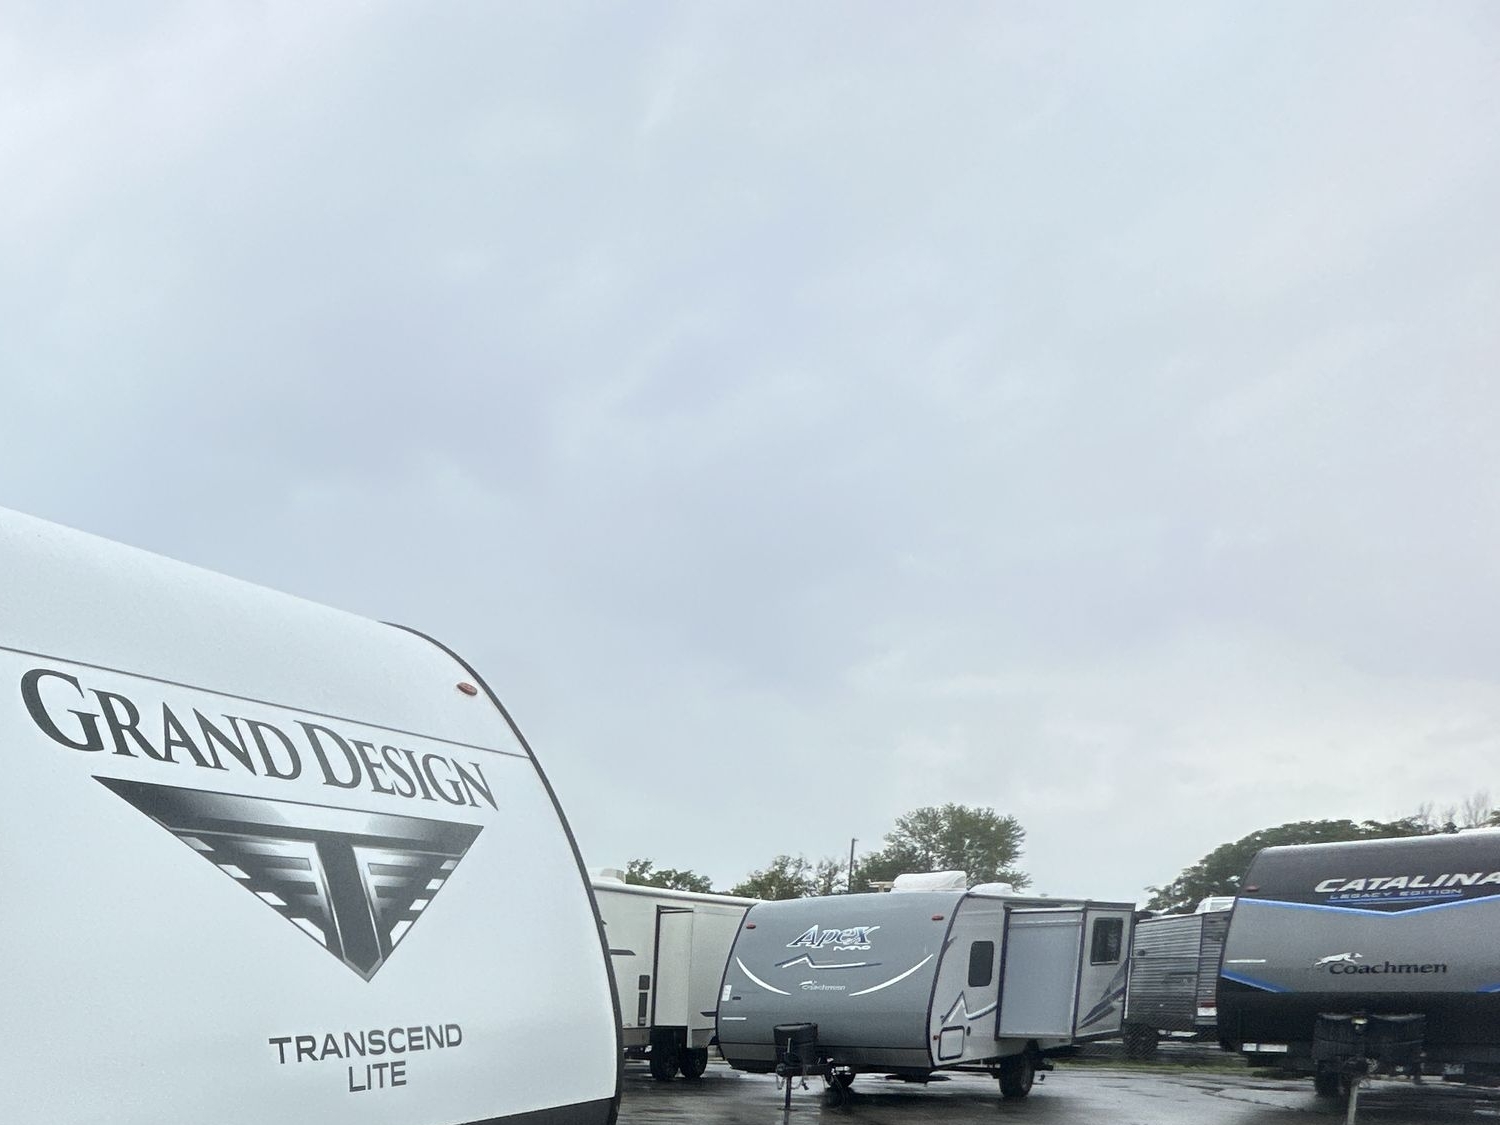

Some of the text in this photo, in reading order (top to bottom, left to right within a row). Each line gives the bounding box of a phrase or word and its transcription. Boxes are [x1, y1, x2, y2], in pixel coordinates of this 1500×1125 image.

[19, 668, 500, 811] GRAND DESIGN
[1314, 872, 1500, 893] CATALINA
[1329, 888, 1462, 900] LEGACY EDITION
[1329, 961, 1447, 975] Coachmen
[269, 1023, 463, 1065] TRANSCEND
[348, 1060, 408, 1093] LITE
